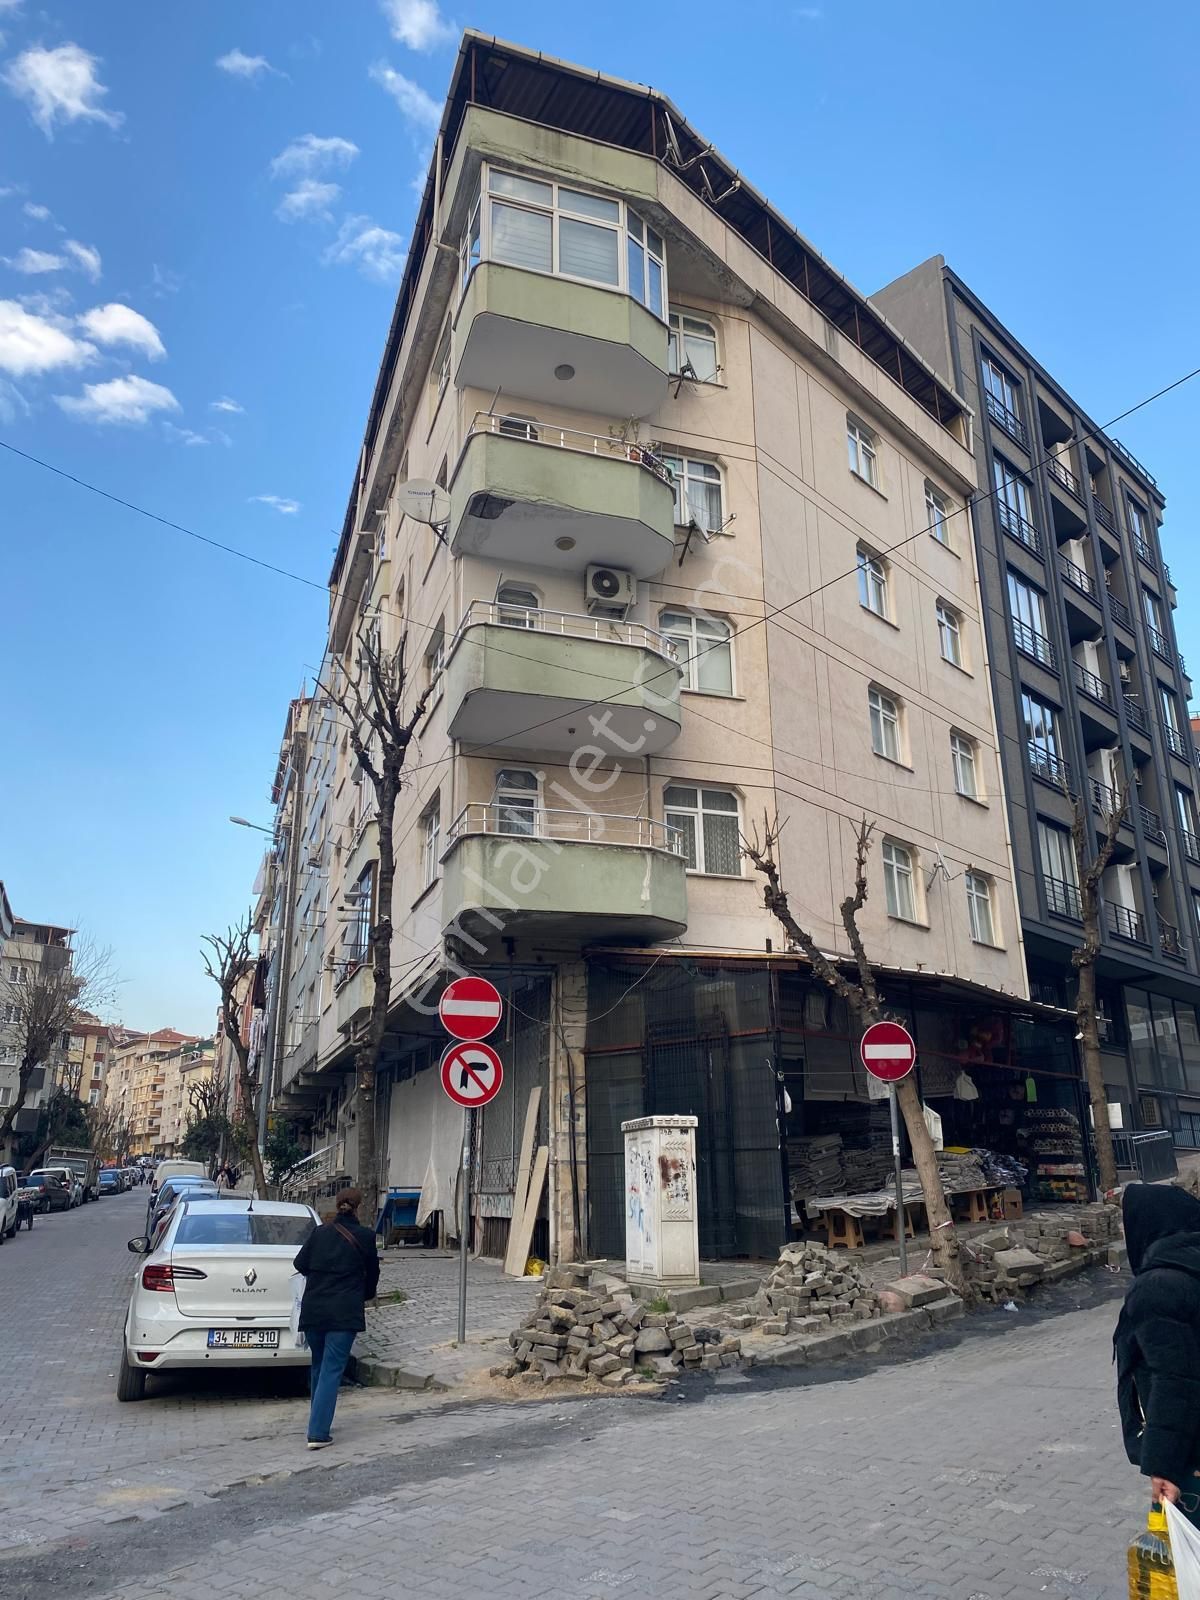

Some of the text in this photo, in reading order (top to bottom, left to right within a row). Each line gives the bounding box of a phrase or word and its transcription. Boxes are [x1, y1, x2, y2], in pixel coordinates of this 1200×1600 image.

[214, 1331, 276, 1343] 34 HEF 910
